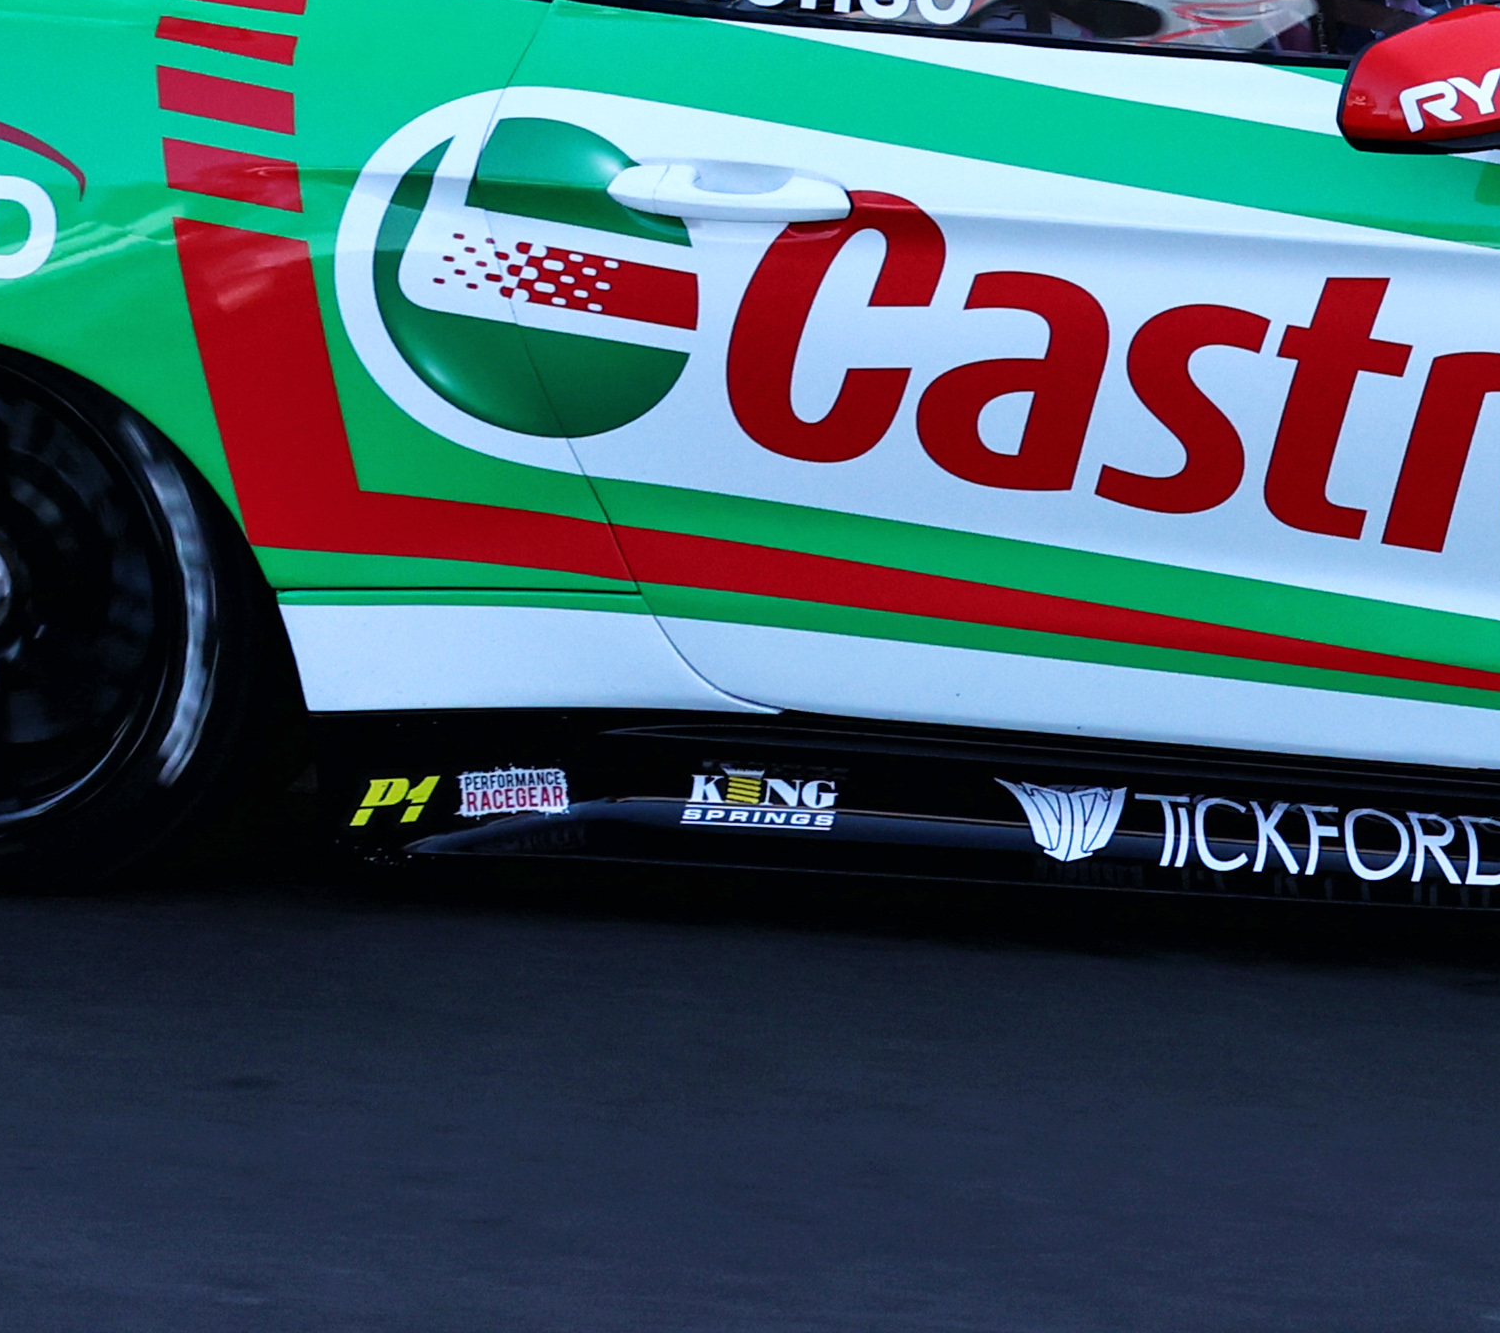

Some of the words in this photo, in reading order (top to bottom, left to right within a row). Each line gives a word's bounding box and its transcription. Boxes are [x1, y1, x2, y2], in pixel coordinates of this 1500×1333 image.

[464, 772, 563, 789] PERFORMANCE
[349, 776, 441, 827] P1
[467, 786, 565, 811] RACEGEAR
[682, 809, 837, 826] SPRINGS
